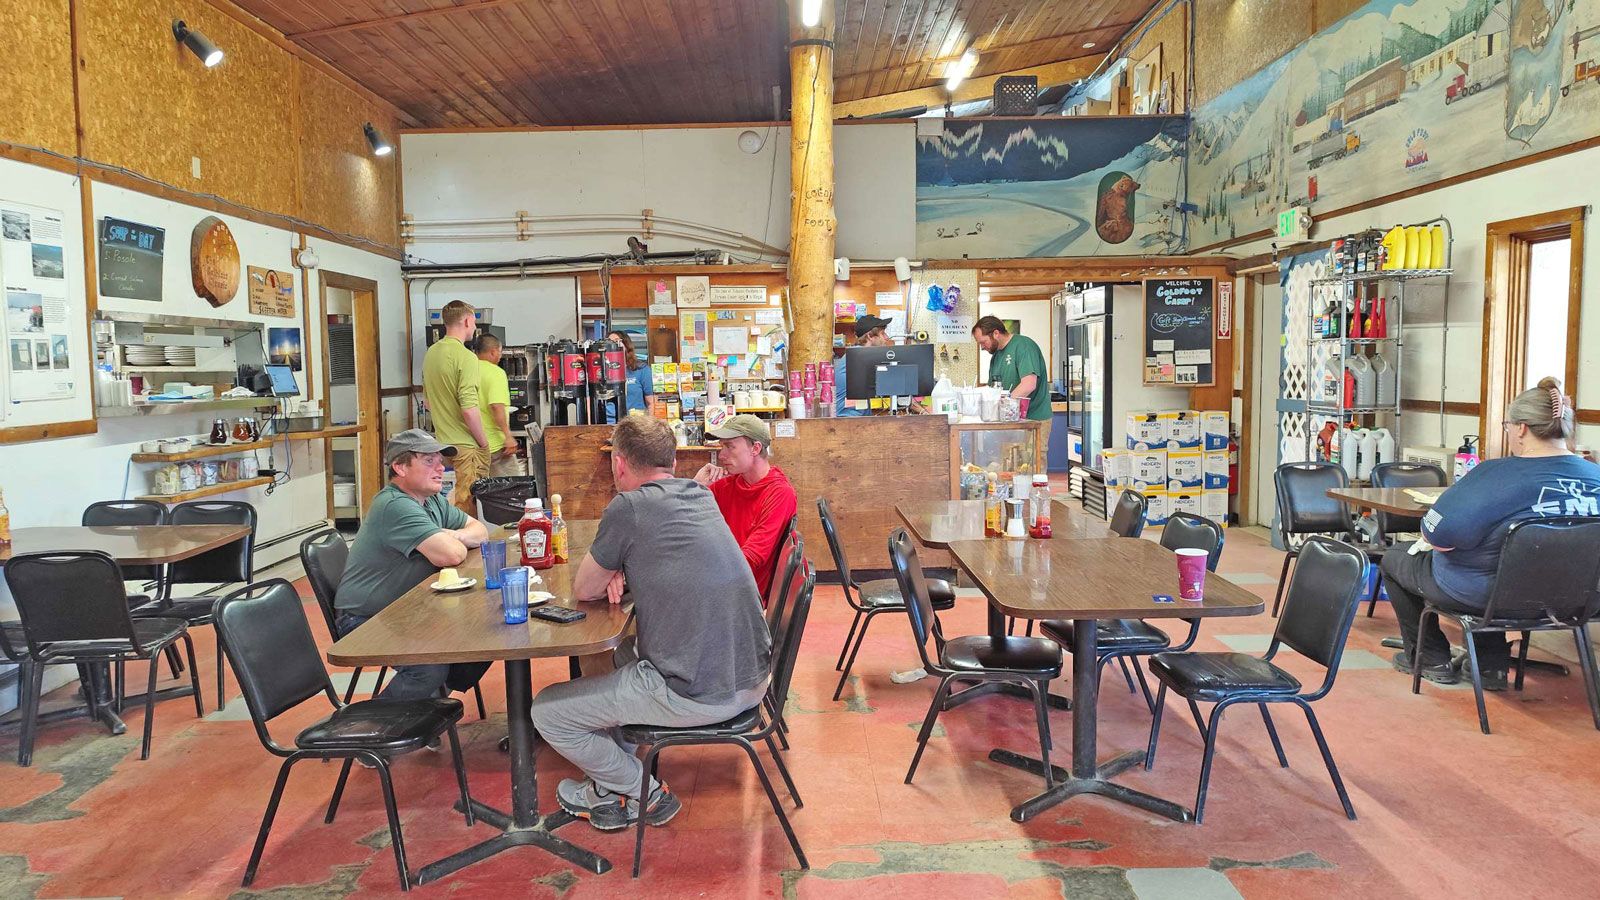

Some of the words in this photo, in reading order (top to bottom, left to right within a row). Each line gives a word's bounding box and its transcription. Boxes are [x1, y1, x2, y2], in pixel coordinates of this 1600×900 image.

[1280, 209, 1296, 237] EXIT
[138, 231, 155, 249] DAY
[1156, 286, 1203, 297] COLDFOOT
